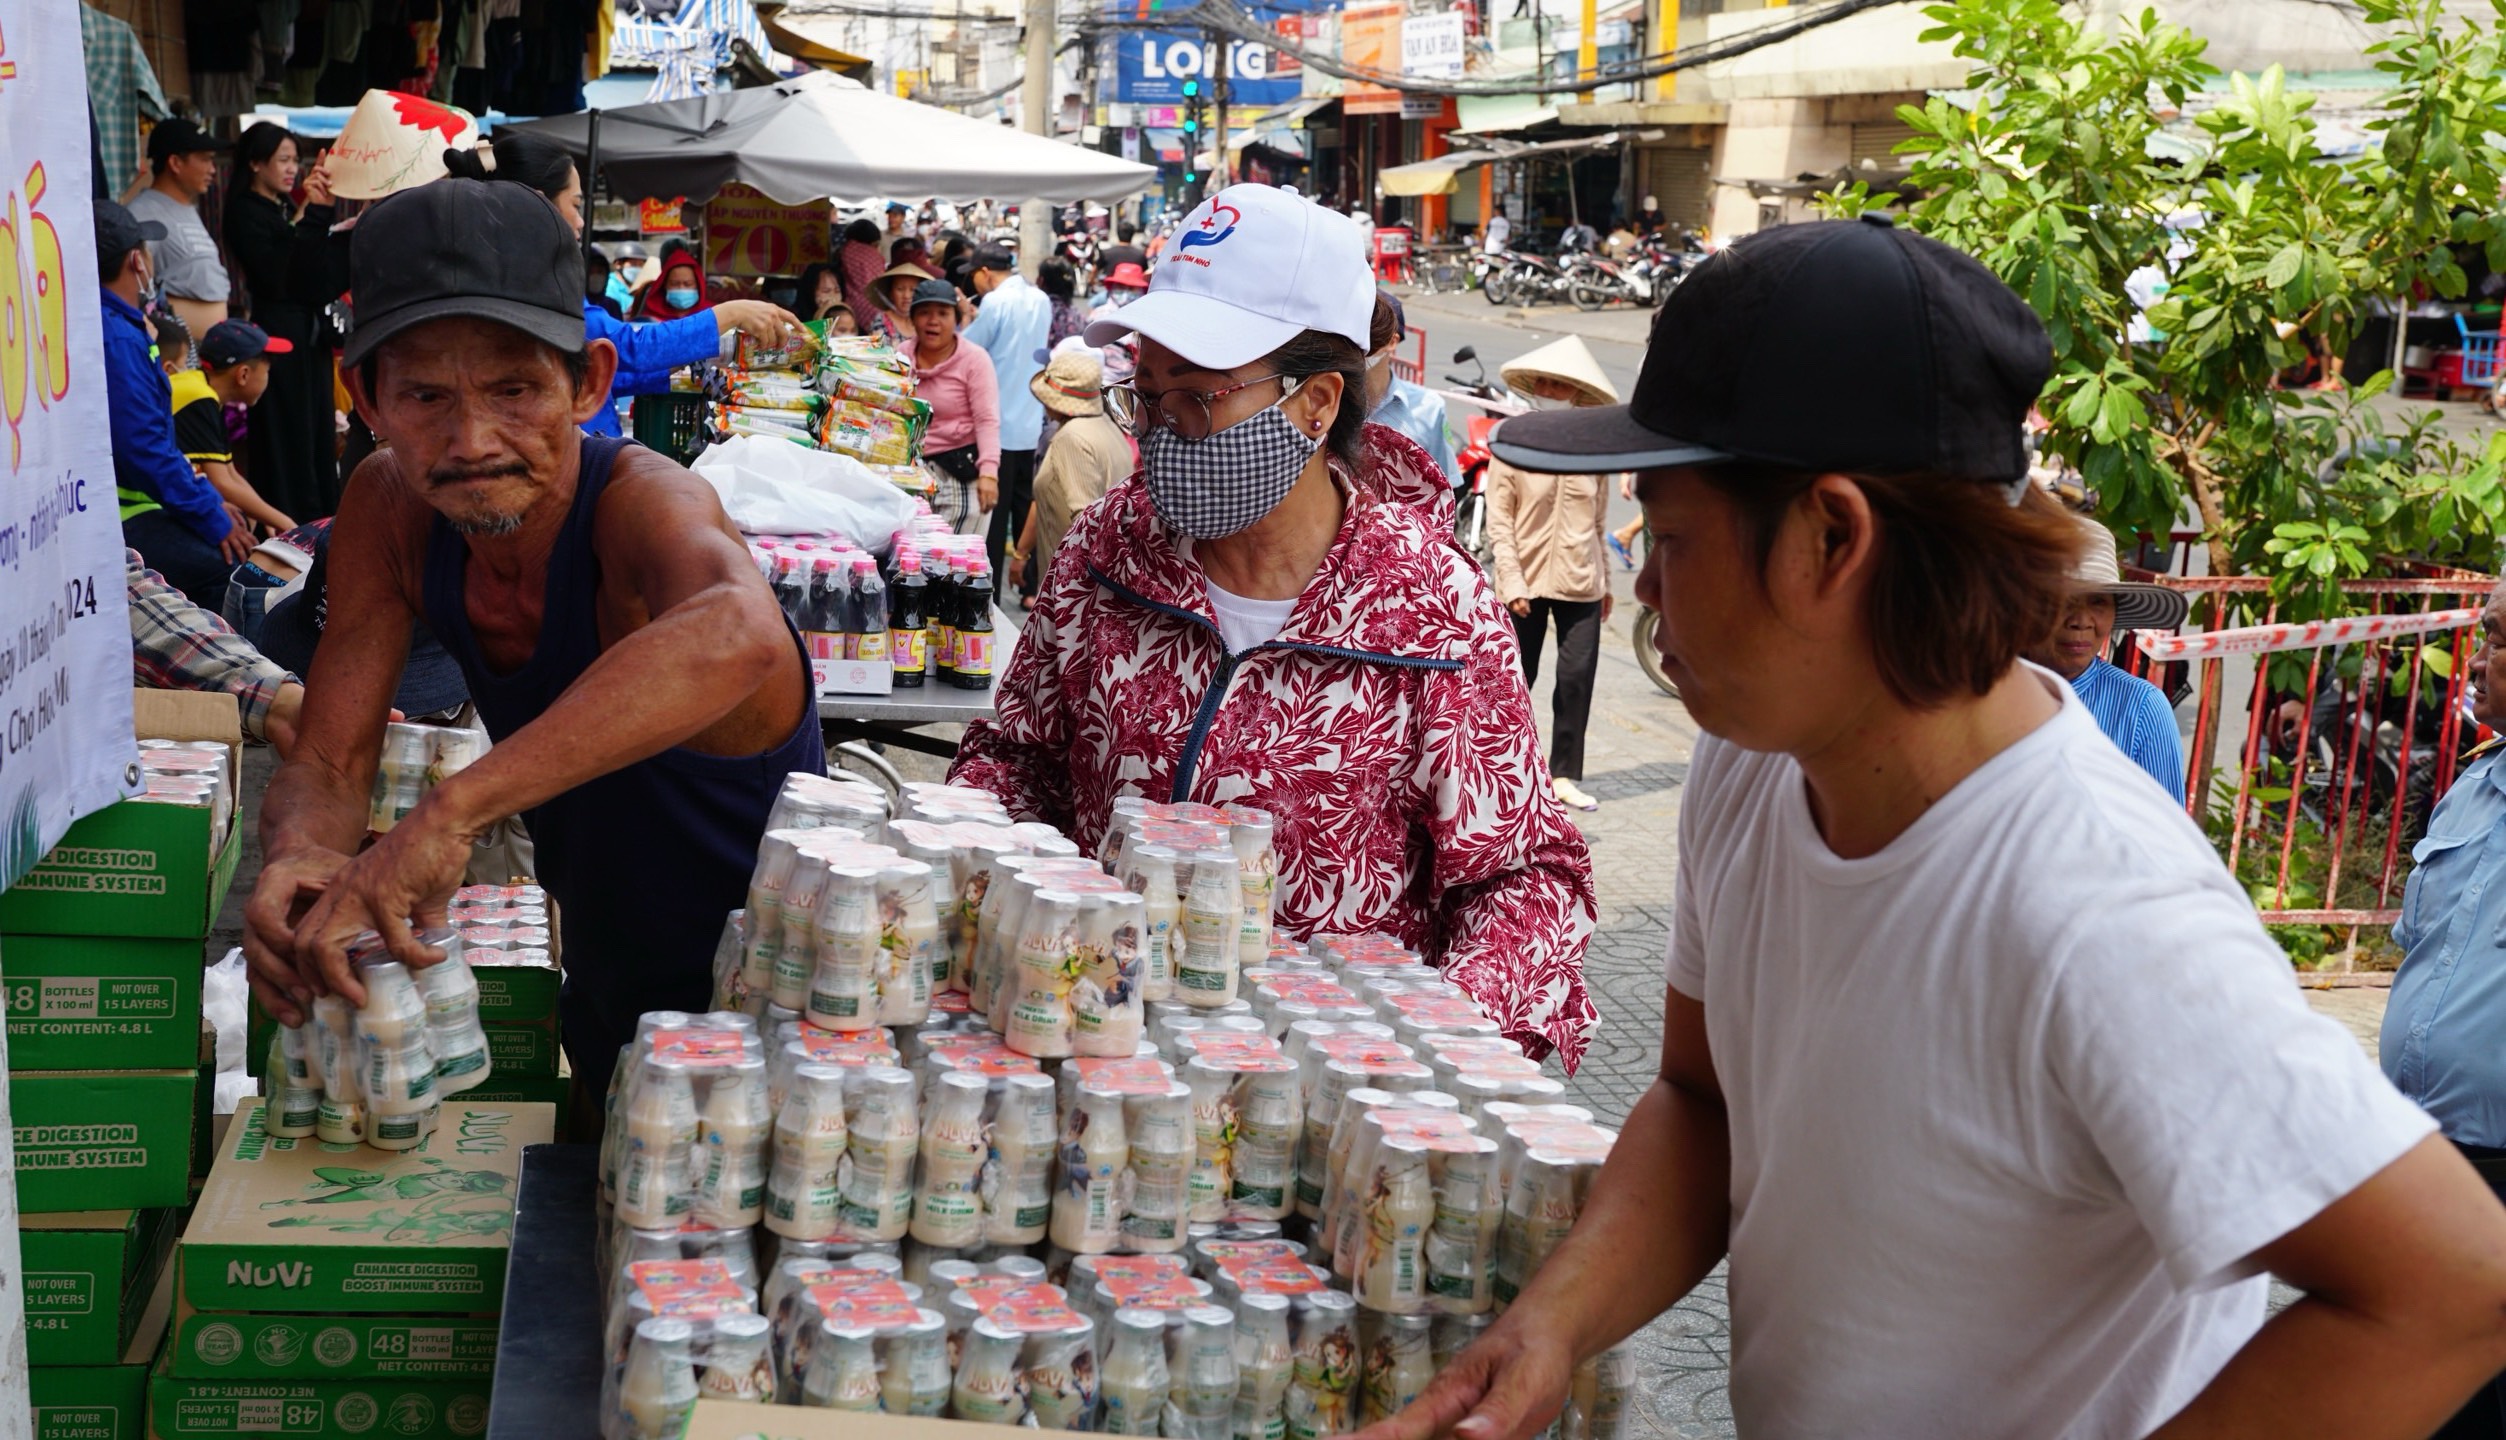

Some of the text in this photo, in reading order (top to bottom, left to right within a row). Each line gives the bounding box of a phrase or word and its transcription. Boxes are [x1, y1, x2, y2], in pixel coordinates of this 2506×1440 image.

[1143, 40, 1267, 80] LONG
[711, 223, 792, 274] 70
[57, 850, 153, 867] DIGESTION
[94, 875, 163, 892] SYSTEM
[45, 987, 95, 997] BOTTLES
[112, 984, 160, 995] NOT OVER
[45, 1000, 93, 1010] X 100 ml
[104, 999, 169, 1010] 15 LAYERS
[7, 1023, 153, 1035] NET CONTENT: 4.8 L
[37, 1127, 135, 1143] DIGESTION
[75, 1151, 143, 1166] SYSTEM
[226, 1259, 313, 1290] NuVi
[355, 1263, 476, 1277] ENHANCE DIGESTION
[27, 1279, 77, 1290] NOT OVER
[344, 1280, 483, 1293] BOOST IMMUNE SYSTEM
[37, 1294, 86, 1305] LAYERS
[34, 1318, 57, 1330] 4.8
[60, 1318, 69, 1329] L
[373, 1334, 406, 1354] 48
[411, 1335, 451, 1343] BOTTLES
[420, 1345, 436, 1353] 100
[455, 1345, 497, 1354] 15 LAYE
[377, 1361, 490, 1373] NET CONTENT: 4.8
[199, 1387, 219, 1397] 4.8
[222, 1387, 287, 1397] CONTENT:
[289, 1387, 315, 1397] NET
[181, 1404, 236, 1414] 15 LAYERS
[255, 1405, 271, 1413] 100
[52, 1413, 101, 1424] NOT OVER
[239, 1416, 280, 1425] BOTTLES
[286, 1405, 319, 1425] 48
[187, 1417, 228, 1426] NOT OVER
[44, 1428, 110, 1439] 15 LAYERS
